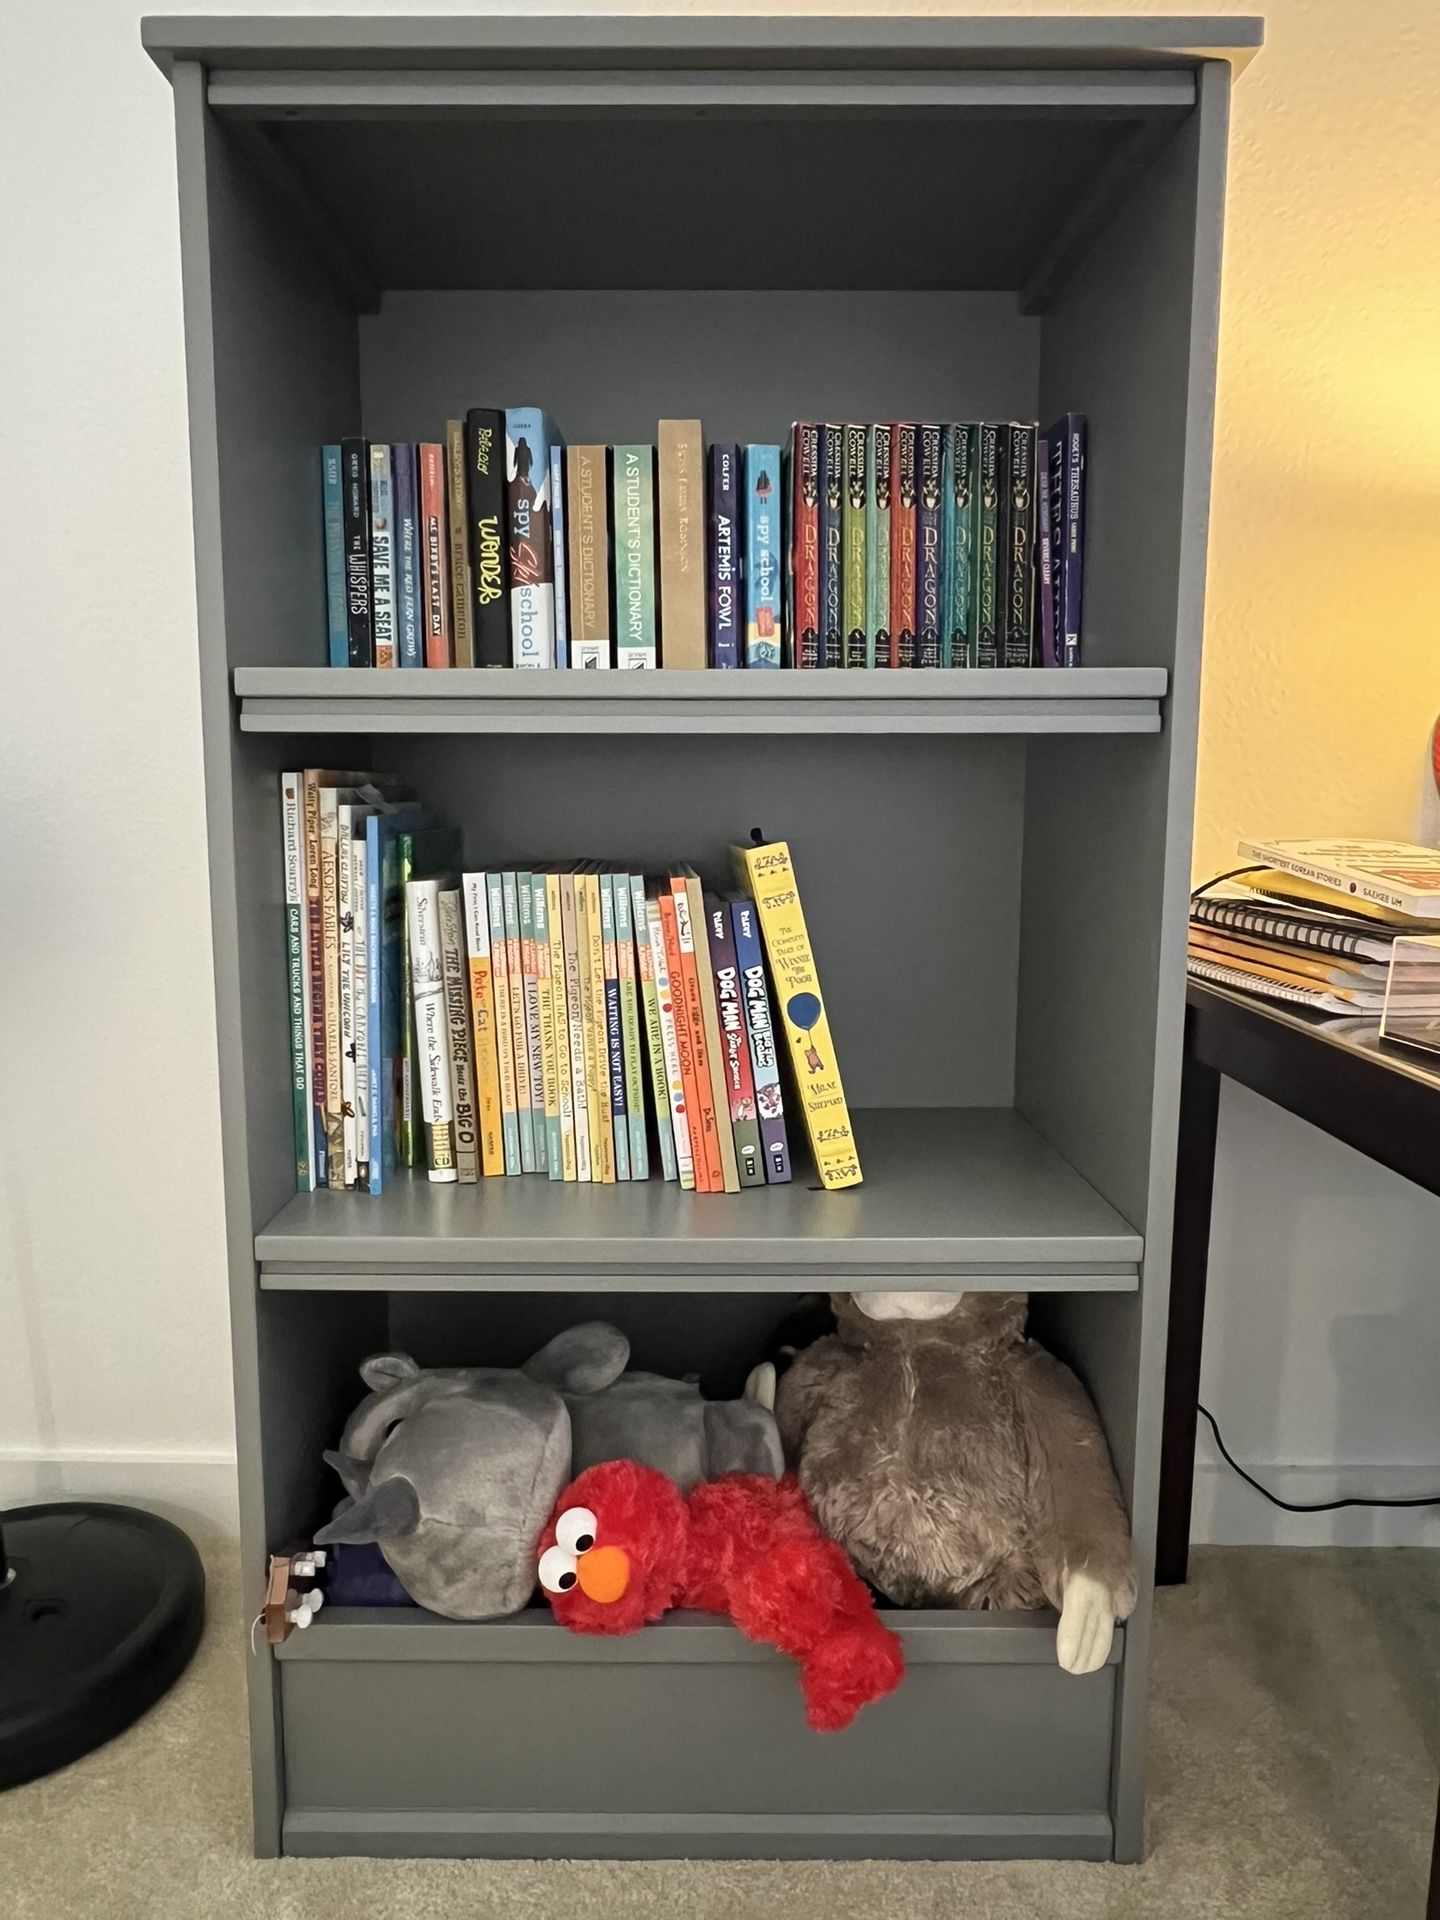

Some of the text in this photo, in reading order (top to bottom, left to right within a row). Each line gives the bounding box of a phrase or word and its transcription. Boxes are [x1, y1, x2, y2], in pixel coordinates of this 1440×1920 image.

[626, 454, 639, 464] A
[722, 454, 730, 491] COLFER
[810, 430, 818, 476] CRESSIDA
[833, 432, 842, 478] CRESSIDA
[856, 432, 864, 478] CRESSIDA
[907, 432, 916, 478] CRESSIDA
[930, 432, 940, 478] CRESSIDA
[626, 467, 640, 549] STUDENT'S
[1070, 467, 1080, 519] THESAURUS
[403, 518, 414, 552] WHERE
[513, 499, 531, 538] spy
[372, 535, 390, 569] SAVE
[580, 456, 596, 628] A STUDENT'S DICTIONARY
[756, 516, 774, 601] spy school
[349, 553, 368, 614] WHISPERS
[374, 574, 390, 593] ME
[404, 574, 414, 593] RED
[430, 537, 442, 636] BIXBY'S LAST DAY
[826, 528, 840, 625] DRAGON
[902, 526, 914, 622] DRAGON
[923, 526, 938, 624] DRAGON
[1012, 527, 1026, 624] DRAGON
[628, 554, 642, 641] DICTIONARY
[718, 586, 730, 630] FOWL
[374, 611, 392, 642] SEAT
[520, 587, 540, 658] school
[308, 810, 318, 834] Piper
[286, 803, 300, 901] Richard Scarry's
[308, 839, 318, 866] Loren
[1262, 853, 1290, 870] SHORTEST
[1291, 863, 1316, 880] KOREAN
[1316, 871, 1342, 888] STORIES
[309, 868, 318, 889] Long
[322, 850, 336, 902] AESOP'S
[416, 896, 428, 946] Silverstein
[490, 888, 500, 928] Willems
[520, 884, 530, 924] Willems
[534, 888, 546, 929] Willems
[618, 888, 628, 928] Willems
[634, 890, 646, 930] Willems
[324, 904, 336, 950] FABLES
[445, 948, 459, 973] THE
[568, 950, 578, 972] The
[592, 935, 602, 964] Don't
[290, 908, 304, 1090] CARS AND TRUCKS AND THINGS THAT GO
[342, 942, 352, 1038] LILY THE UNICORN
[448, 976, 466, 1025] MISSING
[472, 970, 488, 999] Pete
[512, 987, 522, 1014] LET'S
[528, 986, 538, 1020] LOVE
[570, 978, 582, 1020] Pigeon
[596, 989, 604, 1005] the
[718, 966, 742, 1031] DOG MAN
[744, 965, 770, 1030] DOG MAN
[478, 1010, 489, 1031] Cat
[514, 1016, 522, 1029] GO
[648, 998, 658, 1016] WE
[670, 971, 691, 1076] GOODNIGHT MOON
[689, 978, 698, 1002] Green
[696, 1049, 704, 1066] Ham
[328, 1012, 337, 1056] CHARLES
[452, 1028, 468, 1062] PIECE
[530, 1024, 539, 1042] MY
[542, 989, 557, 1107] THE THANK YOU BOOK
[553, 940, 572, 1118] The Pigeon HAS to Go to School!
[573, 1024, 584, 1062] Needs
[608, 988, 624, 1106] WAITING IS NOT EASY!
[630, 1044, 636, 1054] TO
[650, 1020, 660, 1040] ARE
[666, 1017, 678, 1076] PRESS HERE
[426, 1003, 442, 1122] Where the Sidewalk Ends
[516, 1052, 524, 1060] A
[531, 1046, 542, 1070] NEW
[597, 1048, 608, 1076] Drive
[630, 1056, 638, 1075] PLAY
[652, 1044, 662, 1056] IN
[458, 1088, 467, 1102] the
[518, 1062, 526, 1095] DRIVE!
[534, 1076, 544, 1103] TOY!
[576, 1080, 588, 1109] Bath!
[600, 1081, 608, 1098] the
[656, 1068, 667, 1100] BOOK!
[456, 1104, 472, 1128] BIG
[460, 1131, 474, 1143] O
